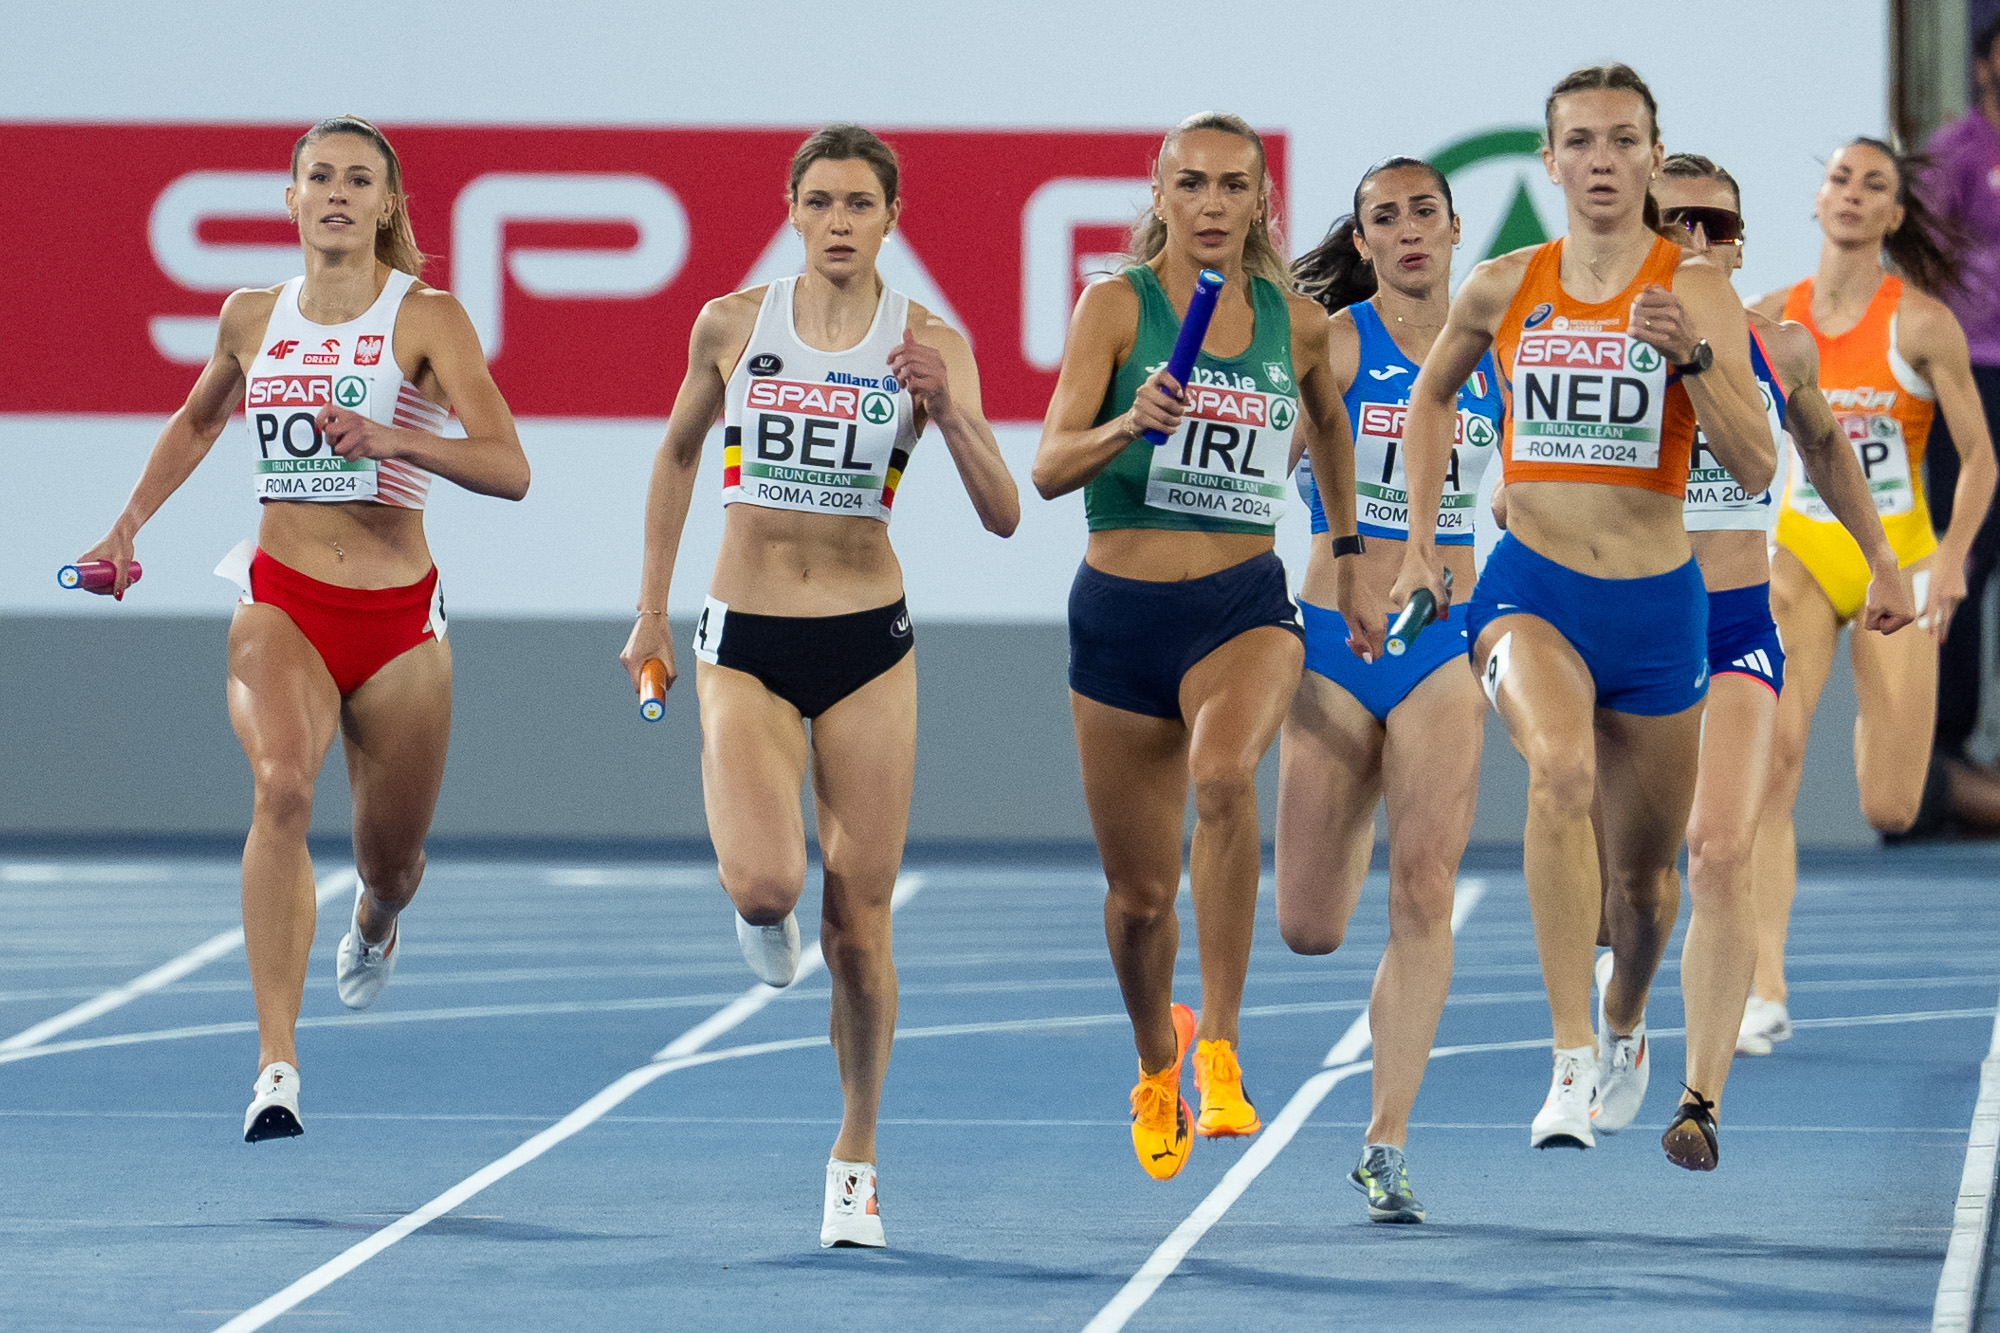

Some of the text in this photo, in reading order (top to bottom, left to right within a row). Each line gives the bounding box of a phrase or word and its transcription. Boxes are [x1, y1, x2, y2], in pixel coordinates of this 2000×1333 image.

[267, 340, 299, 359] 4F
[304, 356, 338, 364] ORLEN
[1522, 338, 1622, 367] SPAR
[250, 379, 330, 403] SPAR
[825, 371, 879, 389] Allianz
[751, 383, 856, 415] SPAR
[1526, 373, 1649, 424] NED
[256, 412, 341, 458] PO
[757, 413, 872, 470] BEL
[1545, 424, 1575, 436] RUN
[1577, 427, 1624, 439] CLEAN
[1181, 420, 1265, 478] IRL
[1529, 441, 1637, 461] ROMA 2024
[296, 460, 341, 472] CLEAN
[773, 469, 805, 482] RUN
[807, 472, 851, 486] CLEAN
[1382, 442, 1460, 491] IA
[1707, 470, 1734, 481] CLE
[265, 476, 356, 493] ROMA 2024
[758, 483, 863, 509] ROMA 2024
[1187, 474, 1219, 488] RUN
[1221, 478, 1259, 494] CLEAN
[1385, 489, 1408, 502] RU
[1168, 488, 1271, 517] ROMA 2024
[1365, 502, 1462, 528] ROM 024
[698, 607, 710, 650] 4
